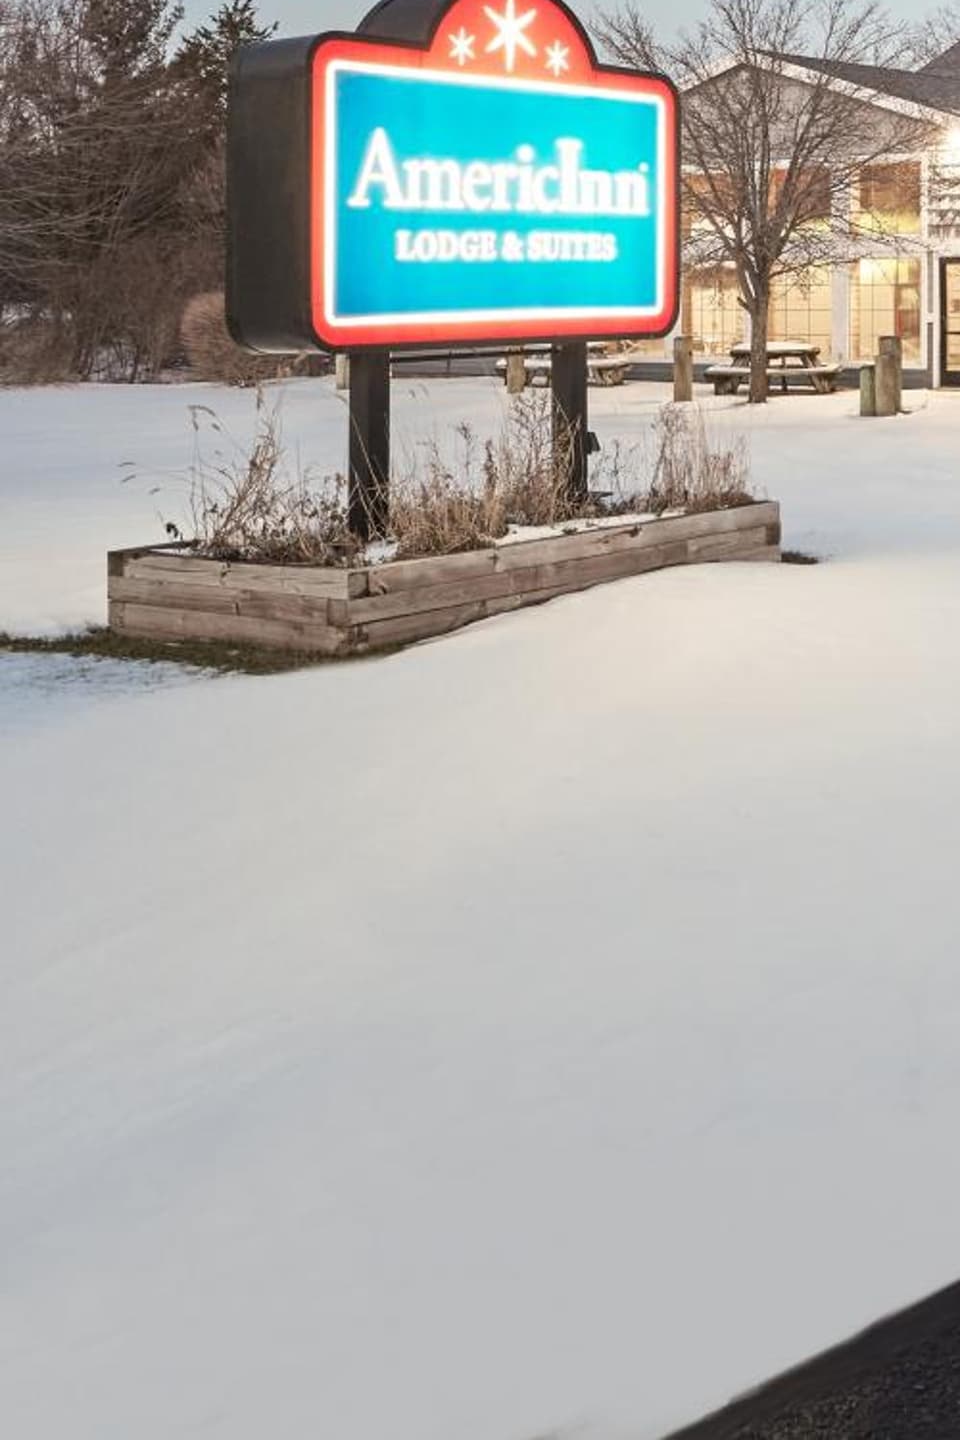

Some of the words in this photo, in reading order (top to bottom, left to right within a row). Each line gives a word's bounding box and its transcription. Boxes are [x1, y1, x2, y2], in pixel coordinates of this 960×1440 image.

[346, 126, 649, 216] AmericInn
[395, 229, 497, 261] LODGE
[501, 231, 524, 261] &
[527, 231, 617, 261] SUITES
